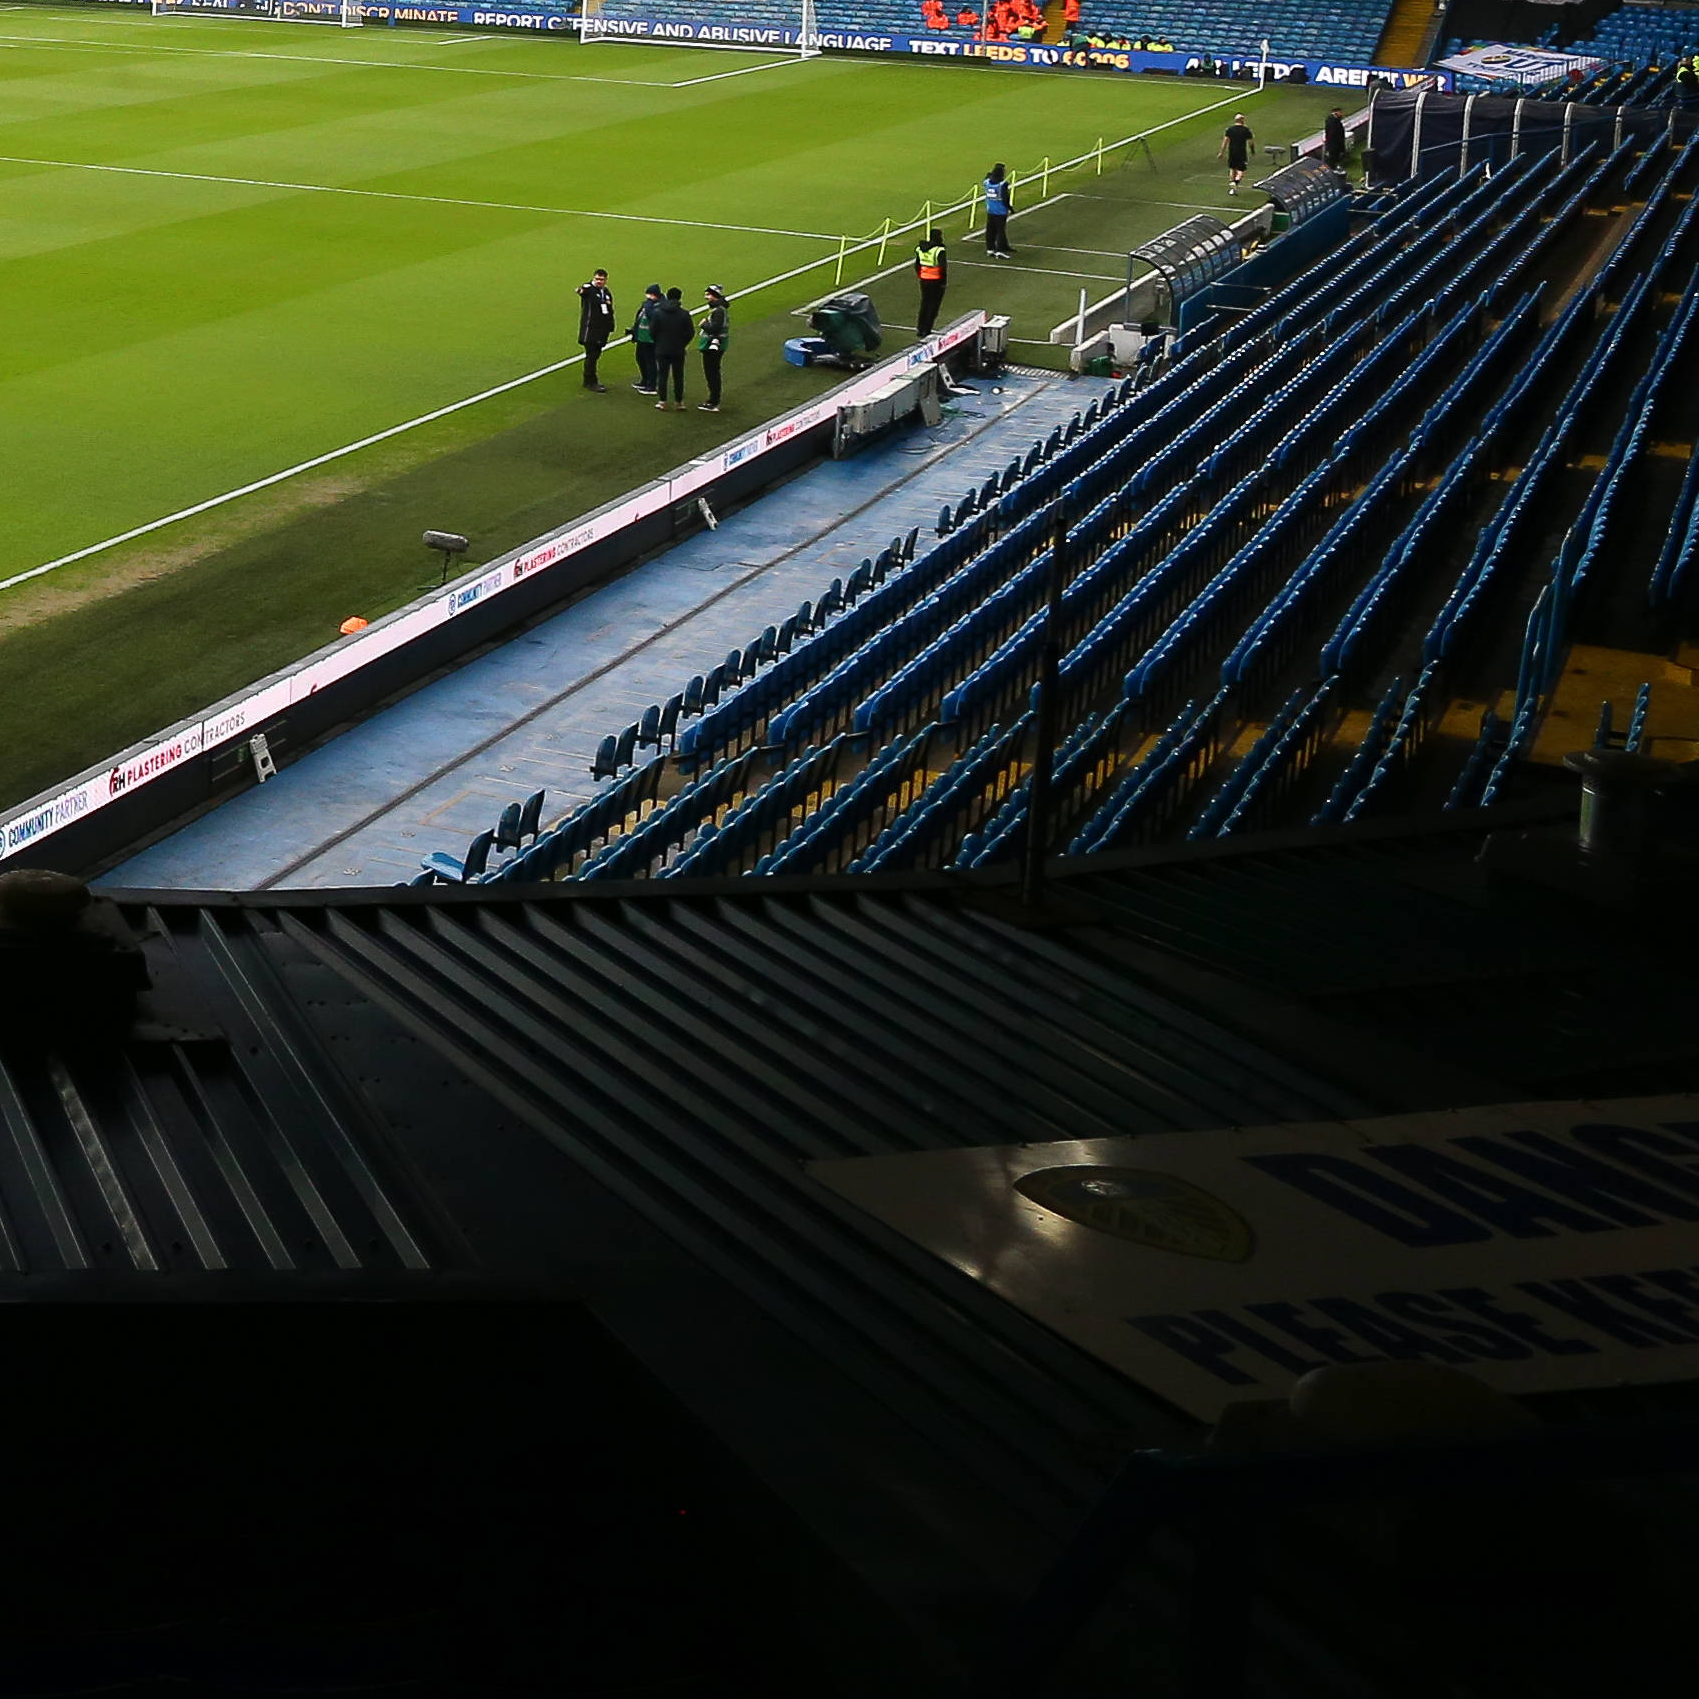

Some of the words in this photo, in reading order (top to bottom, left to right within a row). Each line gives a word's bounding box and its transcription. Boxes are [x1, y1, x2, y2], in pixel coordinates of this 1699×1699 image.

[909, 40, 959, 56] TEXT
[963, 44, 1026, 62] LEEDS
[110, 770, 125, 795] RH
[127, 744, 182, 789] PLASTERING
[184, 712, 245, 754] CONTRACTORS
[8, 806, 54, 848] COMMUNITY
[1240, 1120, 1699, 1248] DANG
[1127, 1287, 1599, 1386] PLEASE
